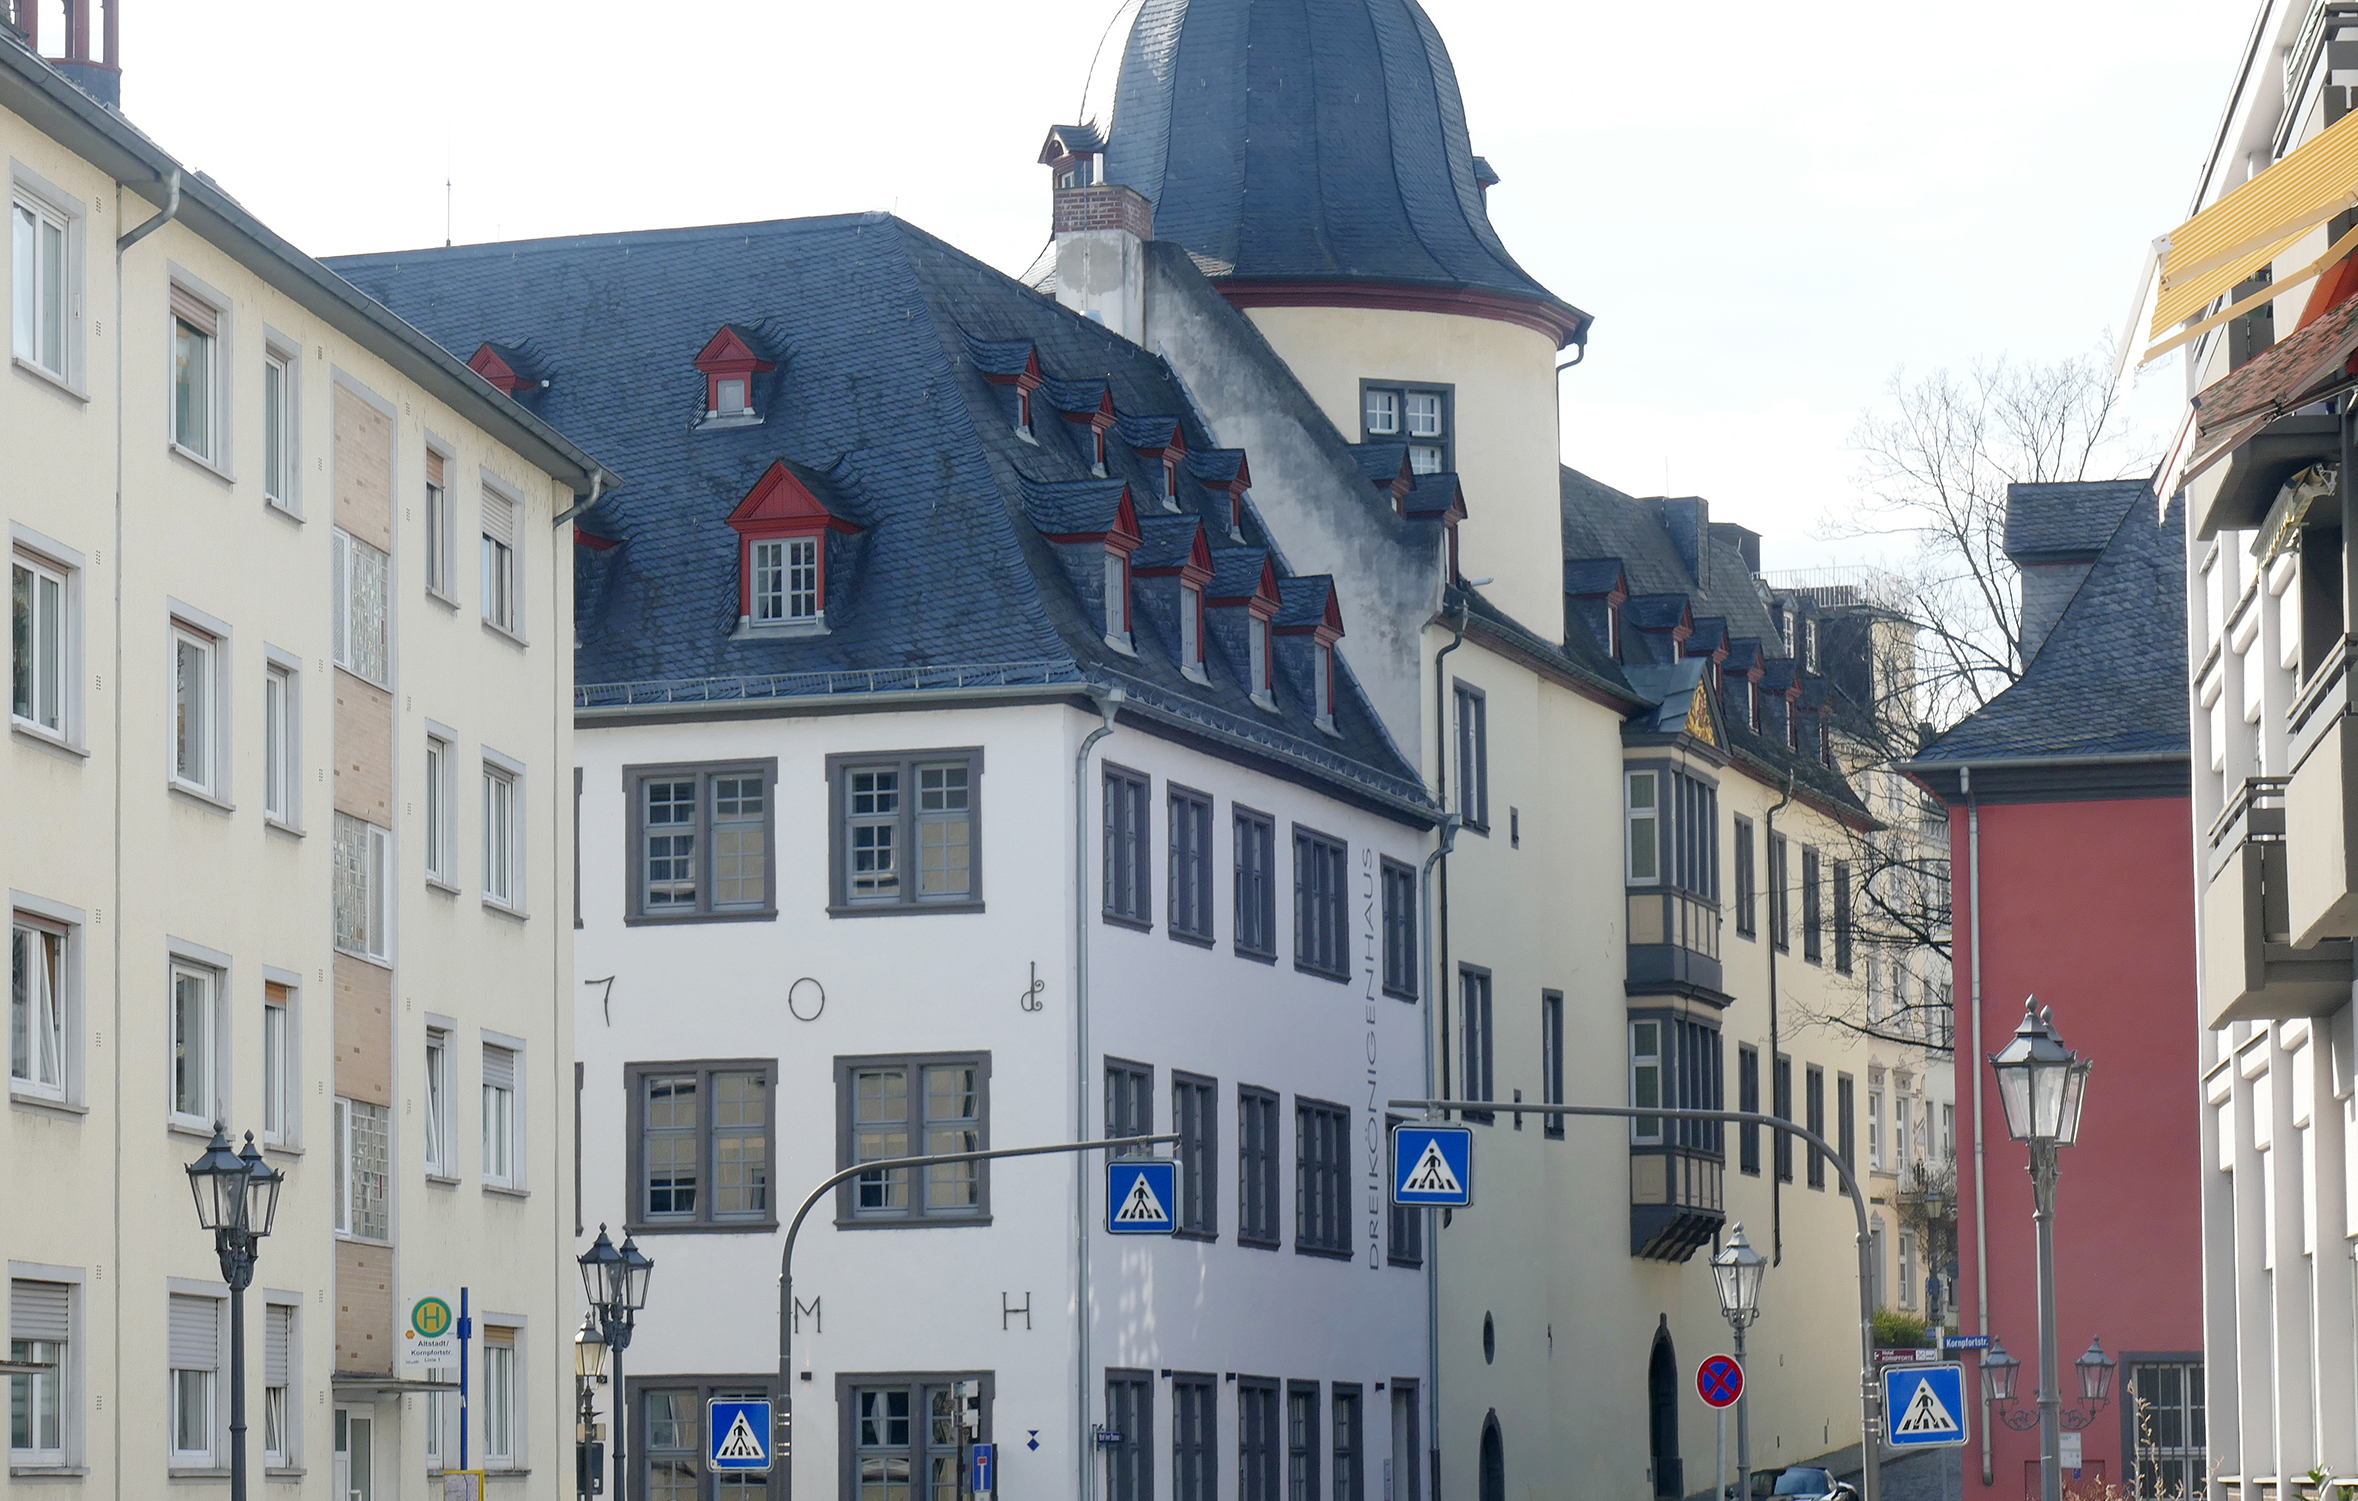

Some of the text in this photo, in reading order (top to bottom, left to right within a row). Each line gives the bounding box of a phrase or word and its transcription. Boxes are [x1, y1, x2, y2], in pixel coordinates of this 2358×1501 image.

[1362, 846, 1379, 1272] DREIKÖNIGENHAUS
[423, 1305, 440, 1329] H
[794, 1291, 1031, 1334] M H
[1945, 1337, 1989, 1349] Kornpfortstr.
